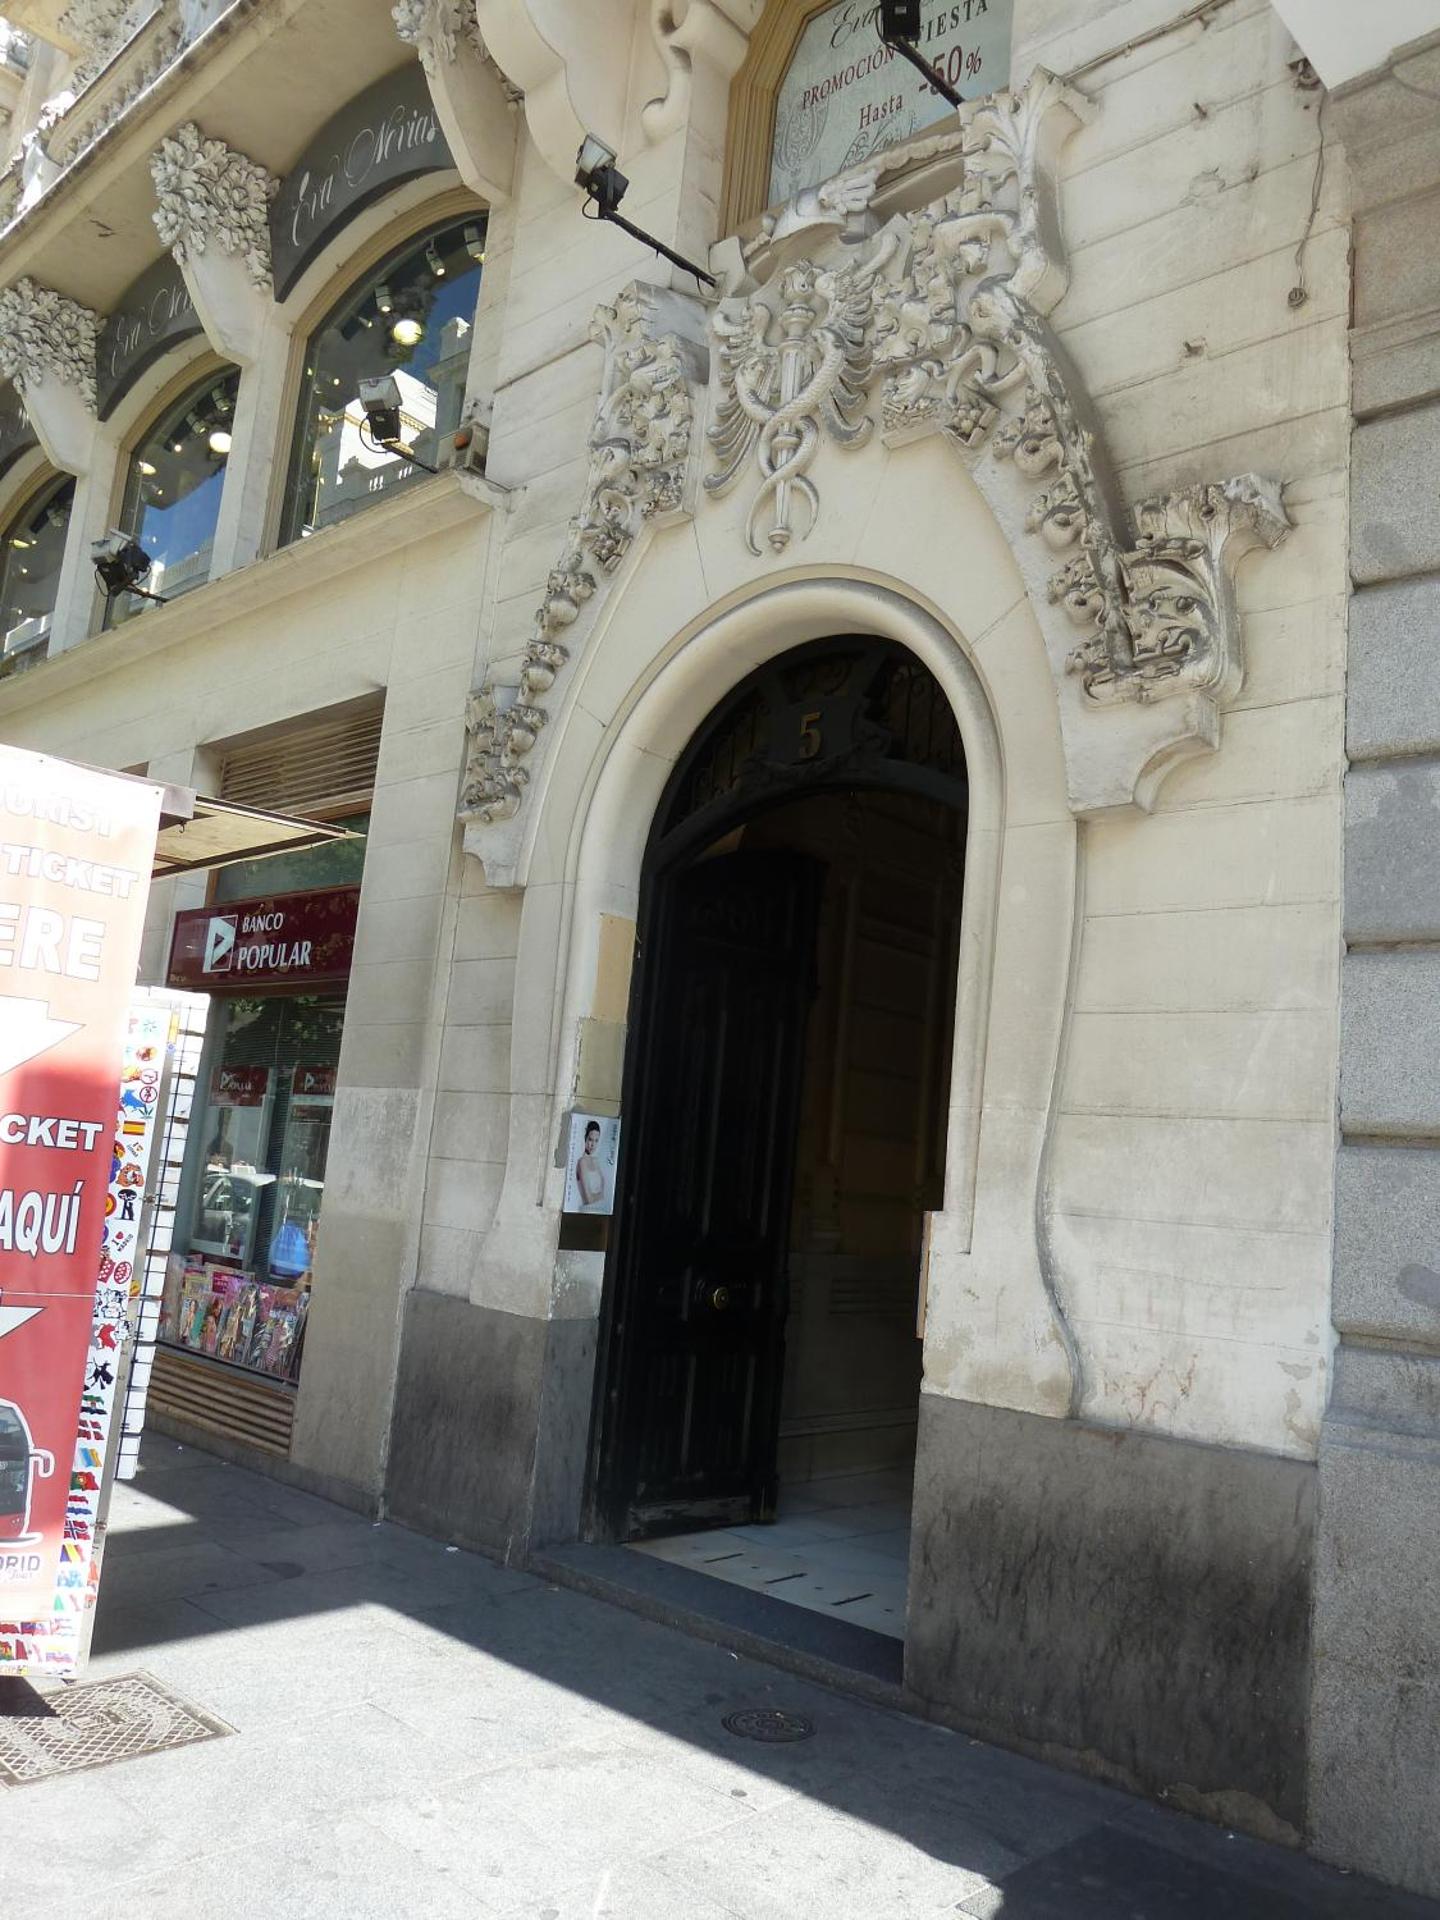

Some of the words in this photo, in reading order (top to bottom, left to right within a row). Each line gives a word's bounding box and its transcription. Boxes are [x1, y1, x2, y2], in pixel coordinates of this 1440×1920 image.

[802, 44, 895, 109] PROMOCIÓN
[859, 94, 903, 129] Hasta
[292, 154, 340, 246] Eva
[799, 711, 821, 759] 5
[0, 782, 115, 838] URIST
[1, 842, 139, 900] TICKET
[241, 912, 284, 933] BANCO
[236, 940, 312, 970] POPULAR
